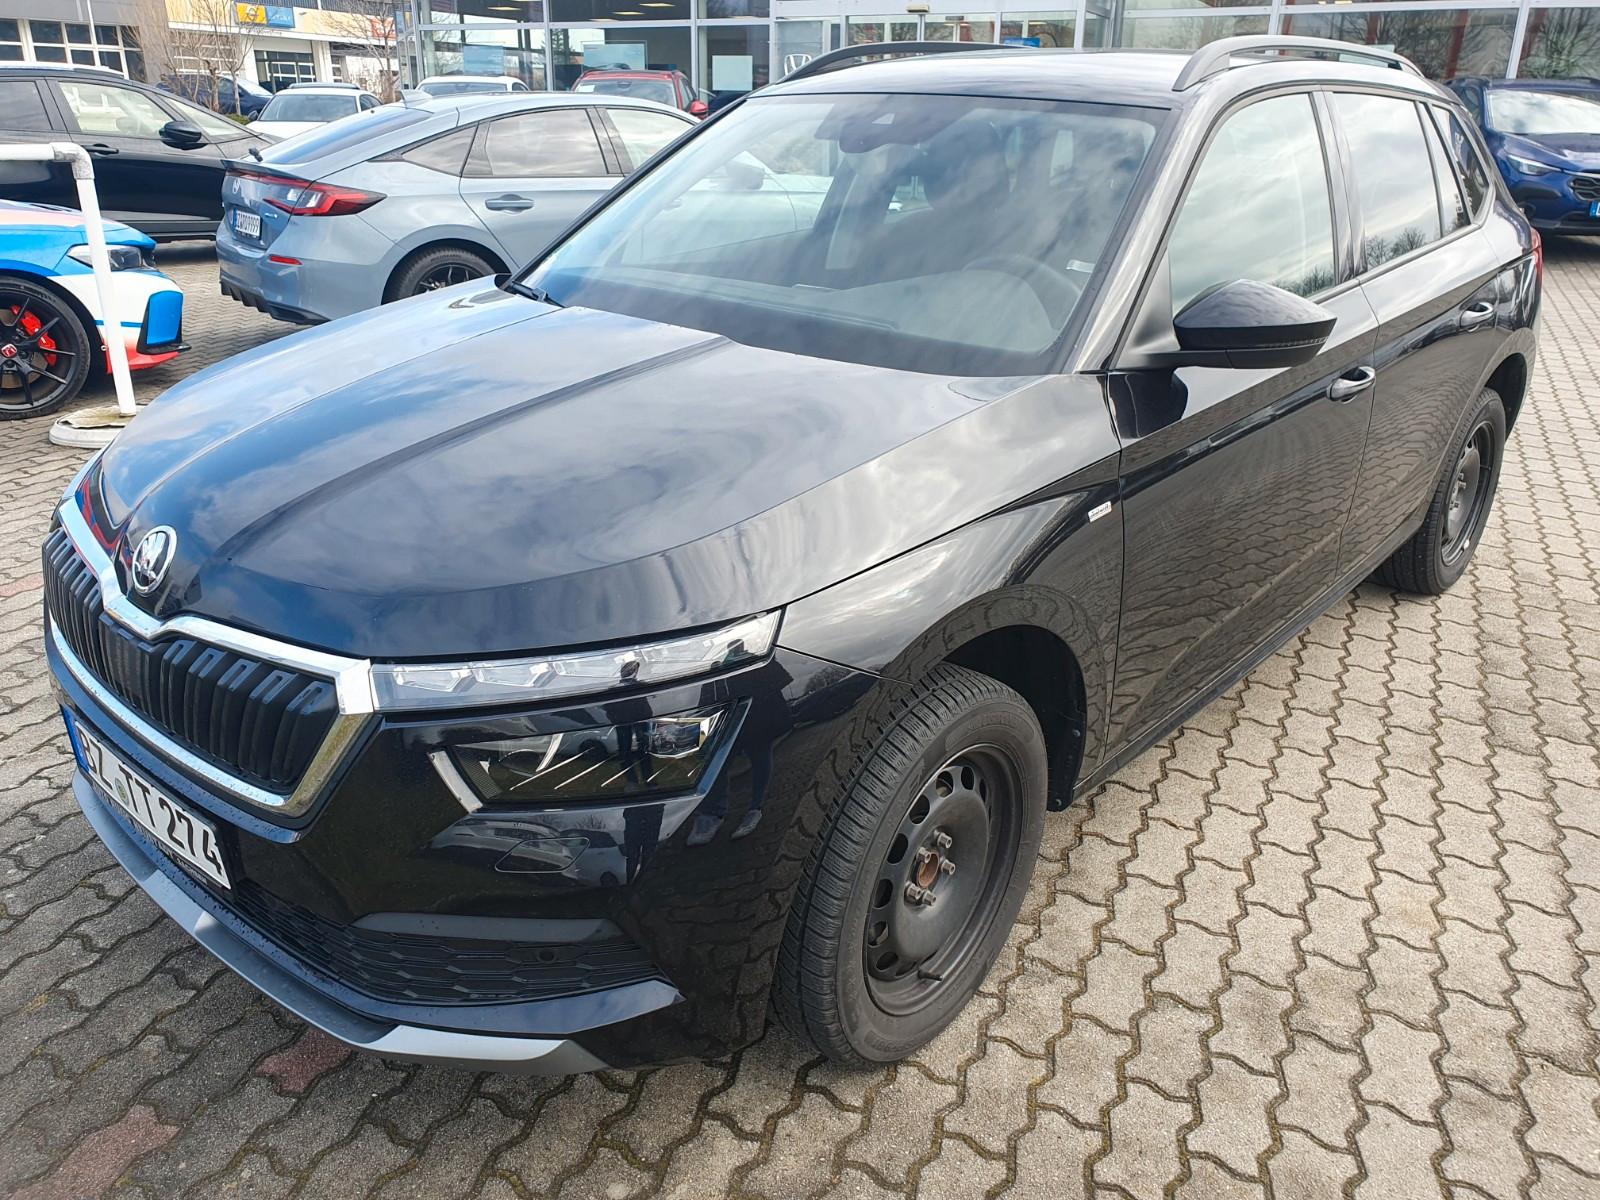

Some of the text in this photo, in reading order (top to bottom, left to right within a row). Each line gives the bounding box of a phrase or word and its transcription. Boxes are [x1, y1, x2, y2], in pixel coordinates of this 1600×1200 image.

[77, 726, 113, 790] BZ
[118, 764, 155, 828] TT
[158, 796, 223, 876] 274
